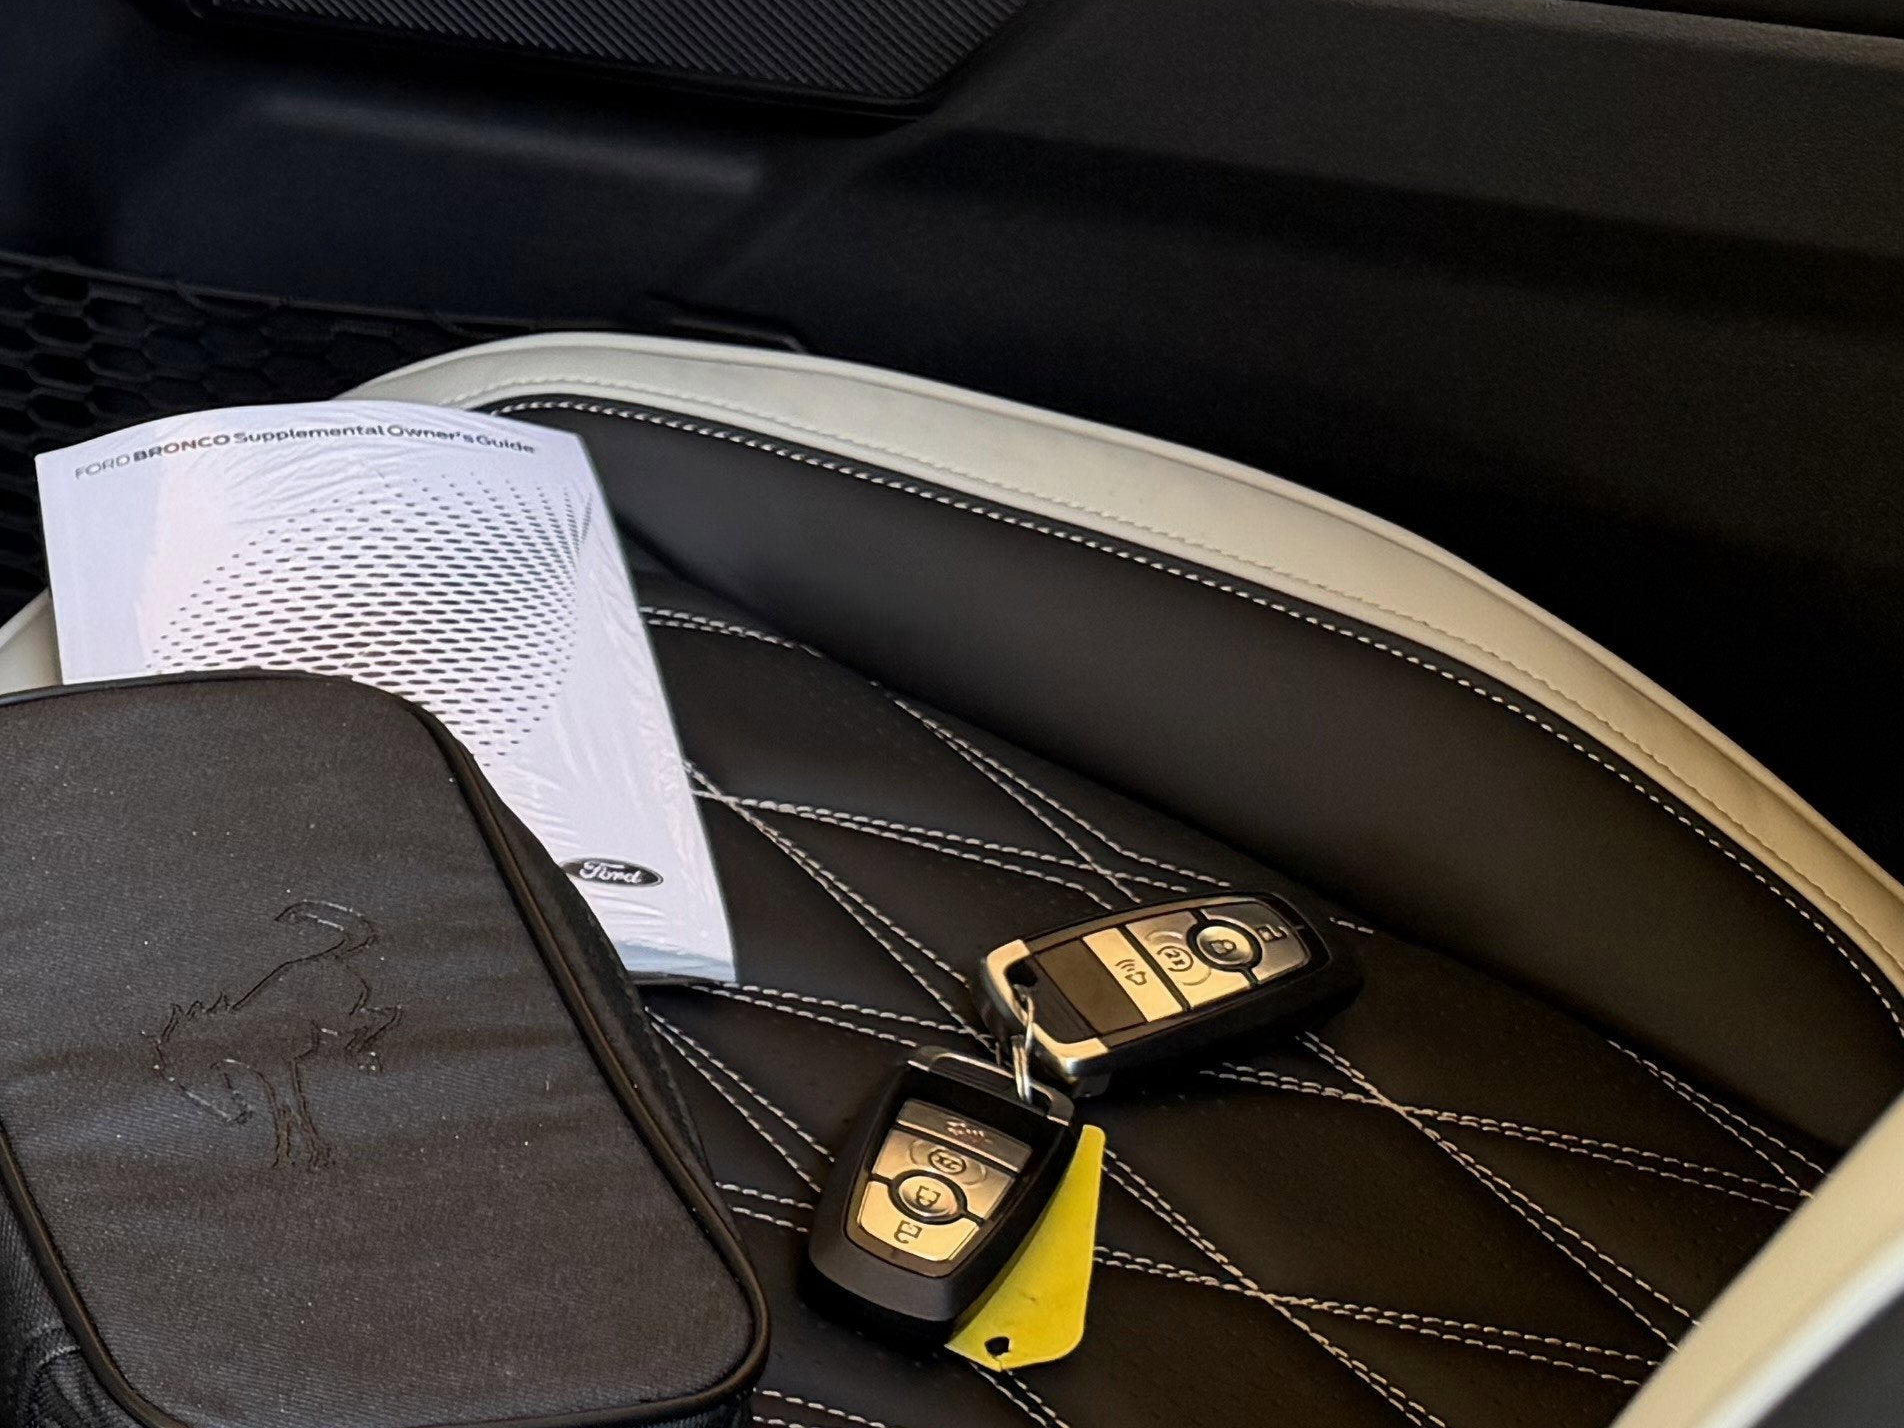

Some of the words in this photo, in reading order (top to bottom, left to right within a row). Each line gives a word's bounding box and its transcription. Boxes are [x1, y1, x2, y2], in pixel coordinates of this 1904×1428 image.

[75, 453, 131, 480] FORD
[133, 434, 231, 463] BRONCO
[233, 425, 385, 445] Supplemental
[387, 424, 474, 445] Owner's
[475, 434, 536, 454] Guide
[579, 860, 642, 884] Ford
